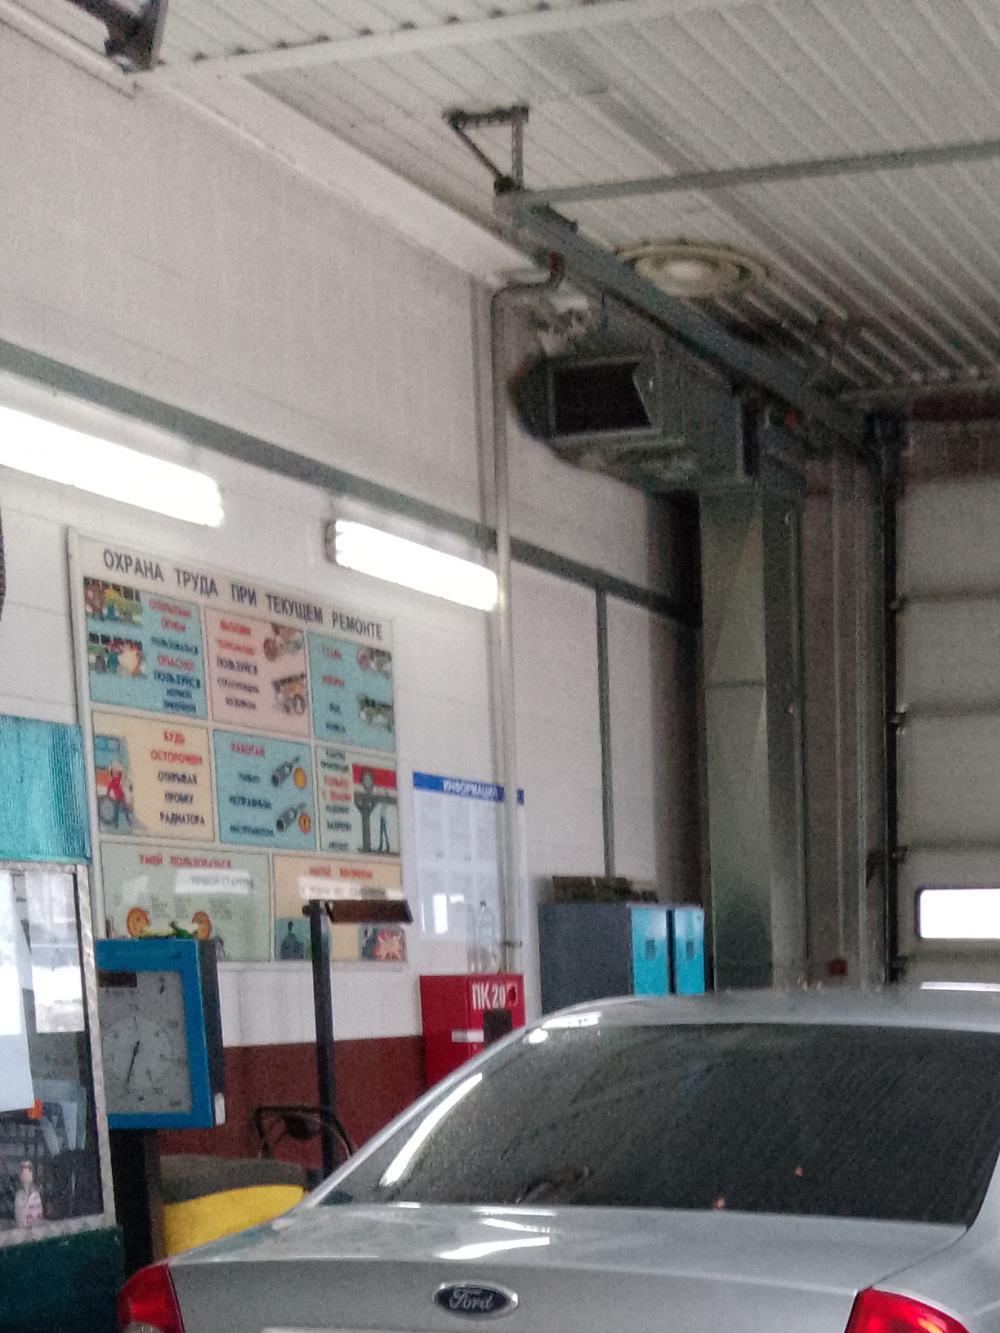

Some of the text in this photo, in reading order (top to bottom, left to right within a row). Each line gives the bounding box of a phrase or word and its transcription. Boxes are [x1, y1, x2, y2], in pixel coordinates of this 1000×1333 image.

[103, 550, 383, 641] ОХРАНА ТРУДА ПРИ ТЕКУЩЕМ РЕМОНТЕ
[472, 982, 491, 1010] ПК
[452, 1288, 494, 1312] Ford
